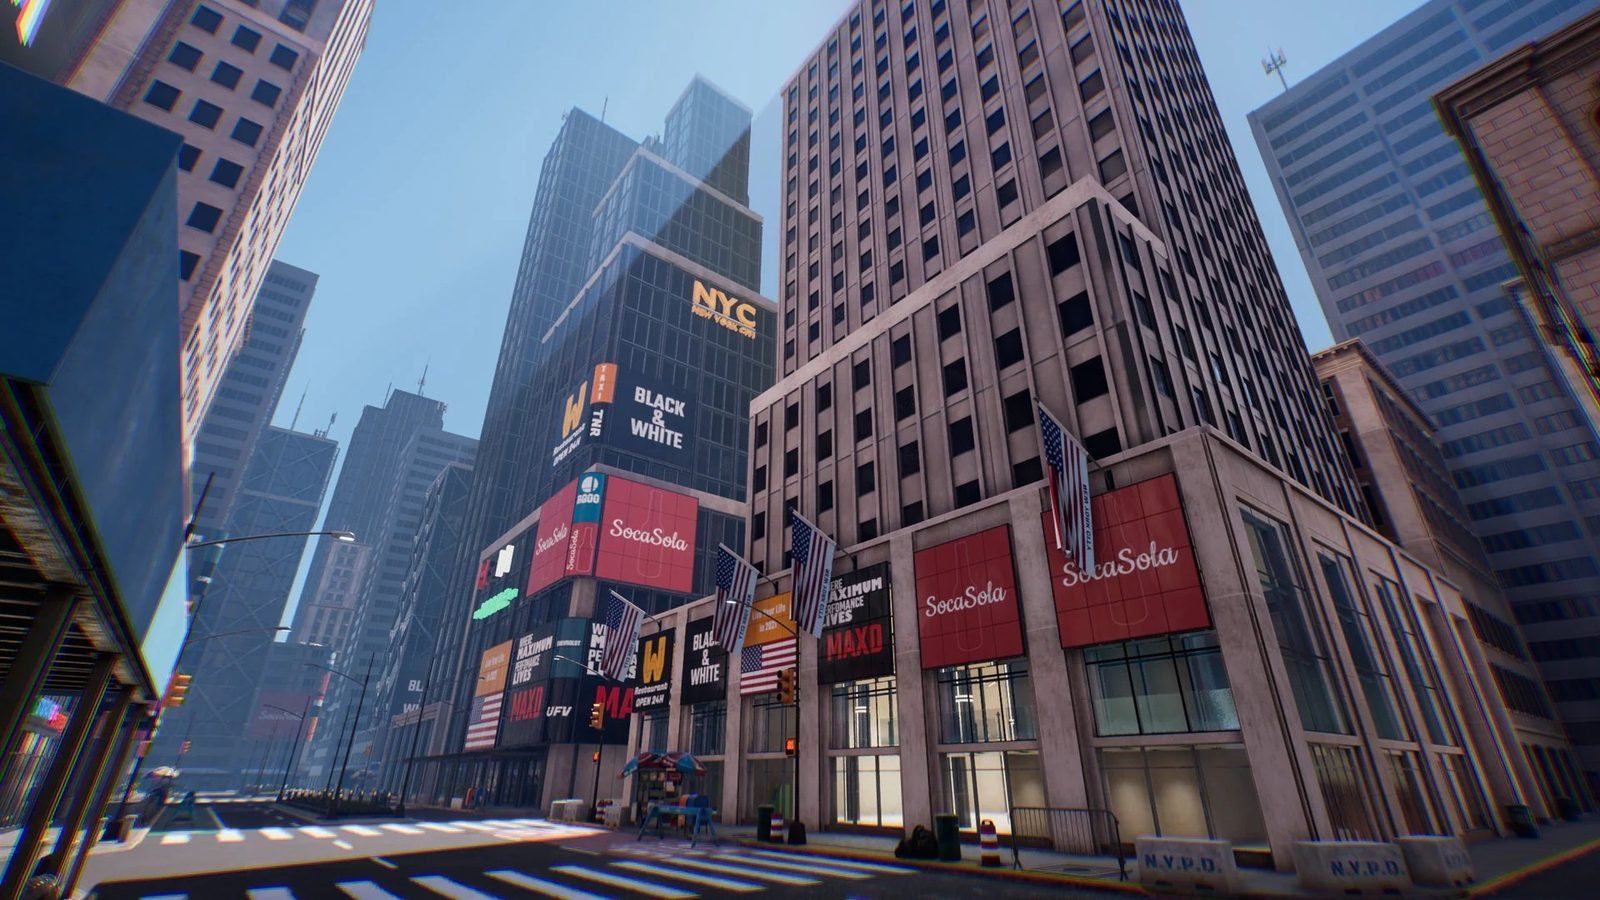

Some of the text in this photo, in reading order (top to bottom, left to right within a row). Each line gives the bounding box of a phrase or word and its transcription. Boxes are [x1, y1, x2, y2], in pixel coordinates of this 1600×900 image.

[692, 280, 756, 329] NYC
[597, 364, 608, 401] TAXI
[562, 380, 588, 440] W
[634, 386, 686, 418] BLACK
[590, 409, 604, 437] TNR
[652, 409, 665, 428] &
[631, 418, 684, 450] WHITE
[566, 529, 579, 571] SocaSola
[609, 518, 689, 552] SocaSola
[1062, 541, 1179, 588] SocaSola
[828, 577, 883, 603] AXIMUM
[831, 578, 843, 592] ERE
[925, 581, 1007, 618] SocaSola
[822, 610, 853, 627] IVES
[693, 630, 721, 651] BLAC
[643, 636, 667, 683] W
[701, 648, 710, 666] &
[512, 667, 533, 685] LIVES
[690, 663, 720, 686] WHITE
[635, 696, 651, 708] OPEN
